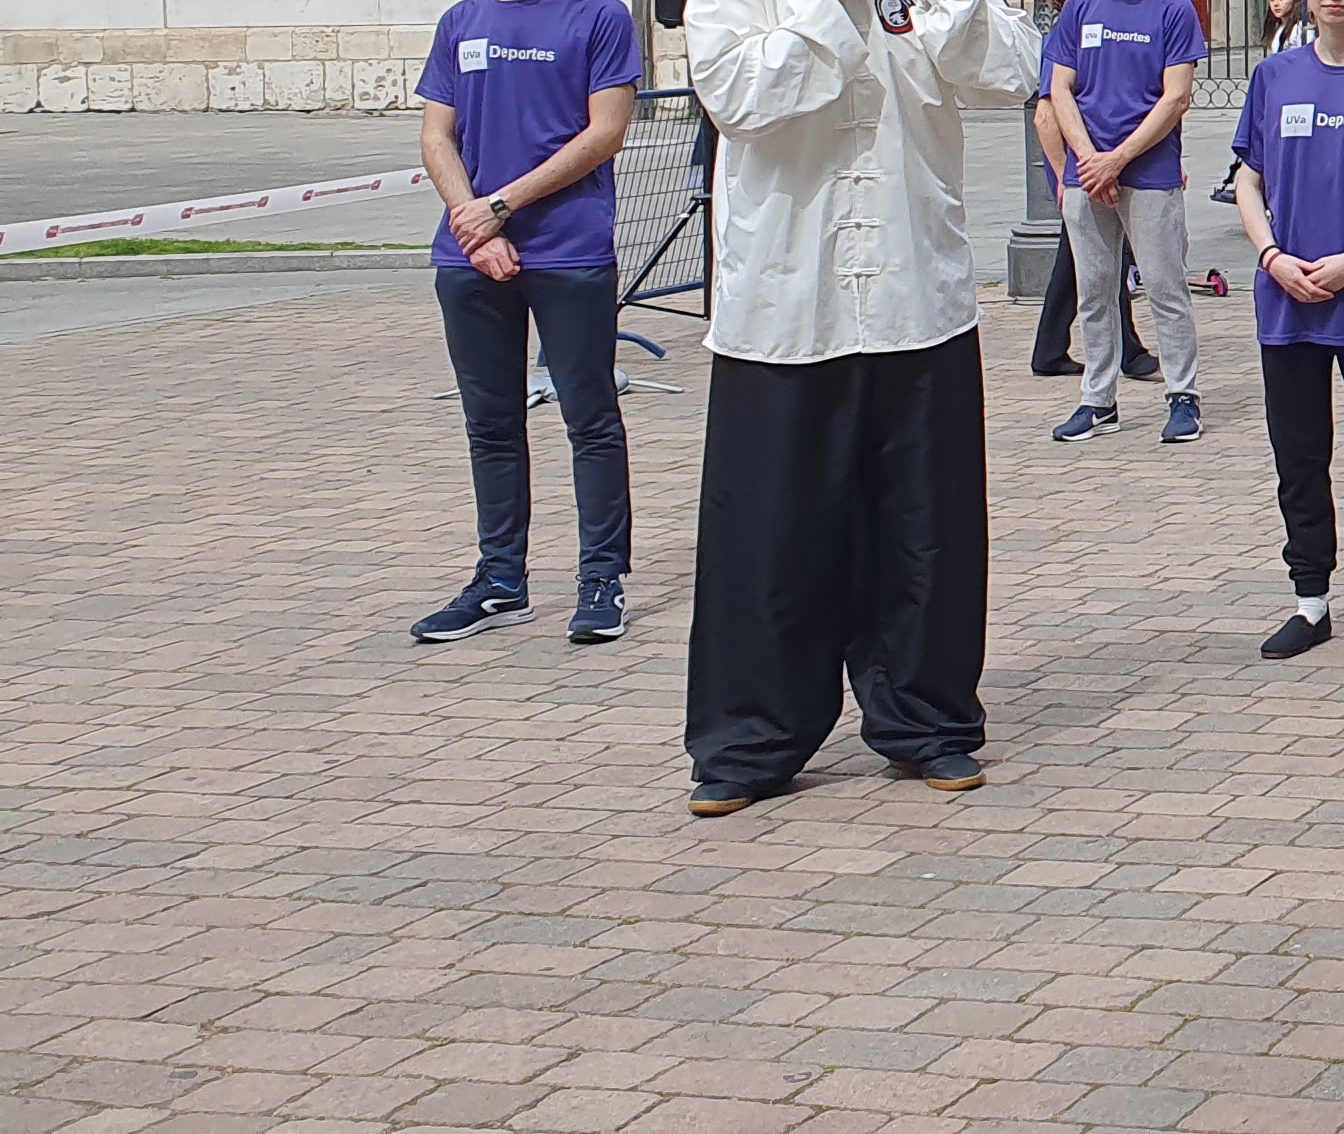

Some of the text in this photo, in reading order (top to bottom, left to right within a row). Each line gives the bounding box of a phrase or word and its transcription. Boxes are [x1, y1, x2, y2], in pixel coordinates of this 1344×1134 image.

[1103, 28, 1151, 43] Deportes
[489, 45, 555, 62] Deportes
[1286, 115, 1307, 125] UVa
